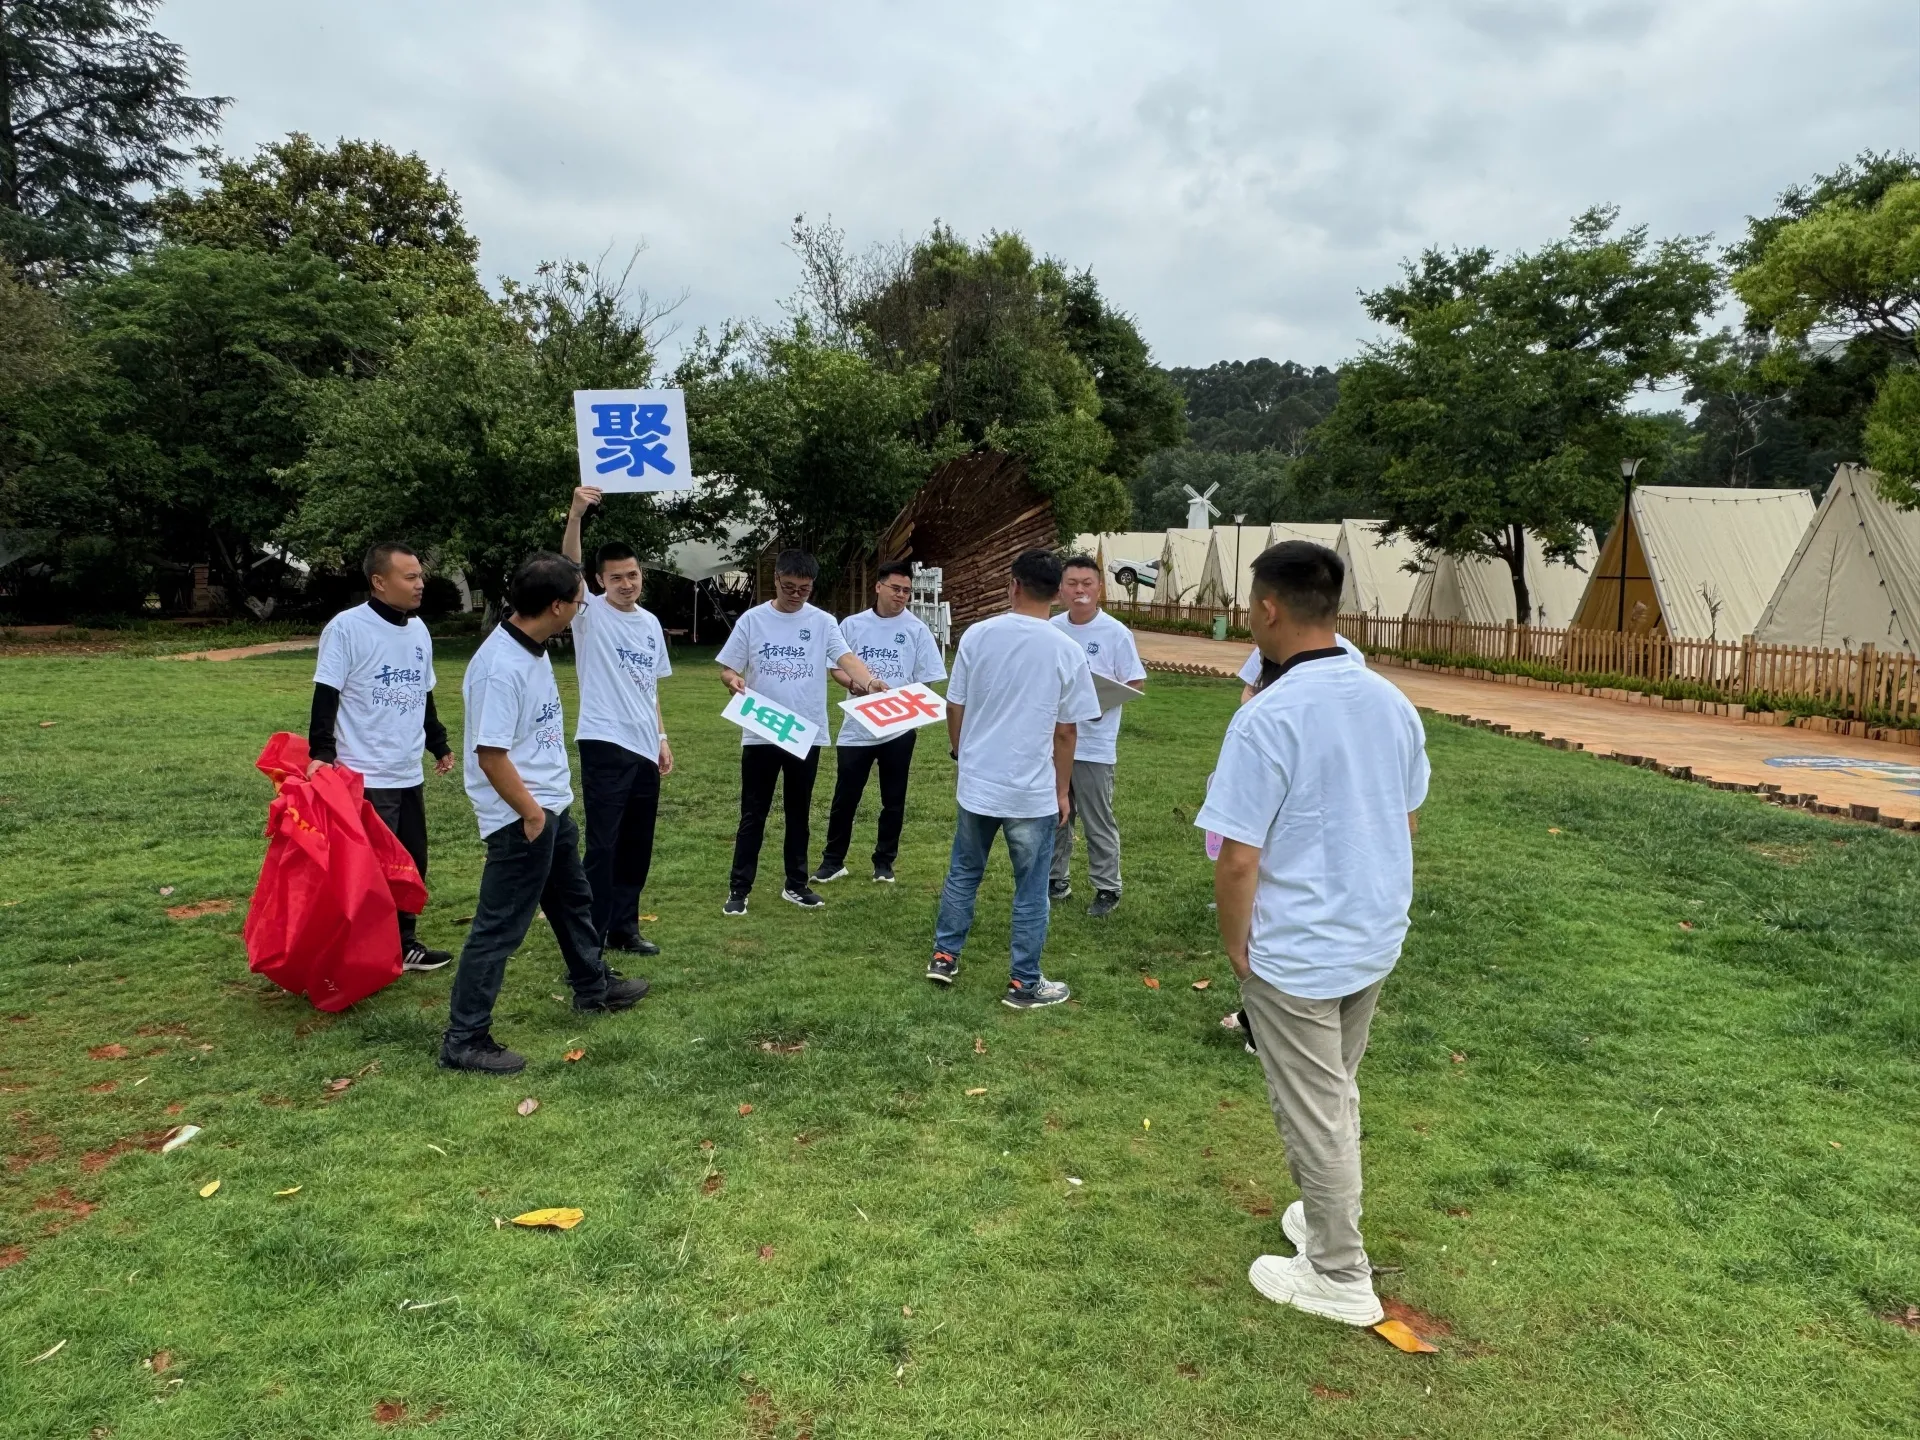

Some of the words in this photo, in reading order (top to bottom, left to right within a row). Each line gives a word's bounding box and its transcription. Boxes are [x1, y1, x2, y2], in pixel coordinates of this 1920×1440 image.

[591, 404, 676, 478] 聚
[740, 696, 806, 744] 再
[855, 690, 941, 728] 首
